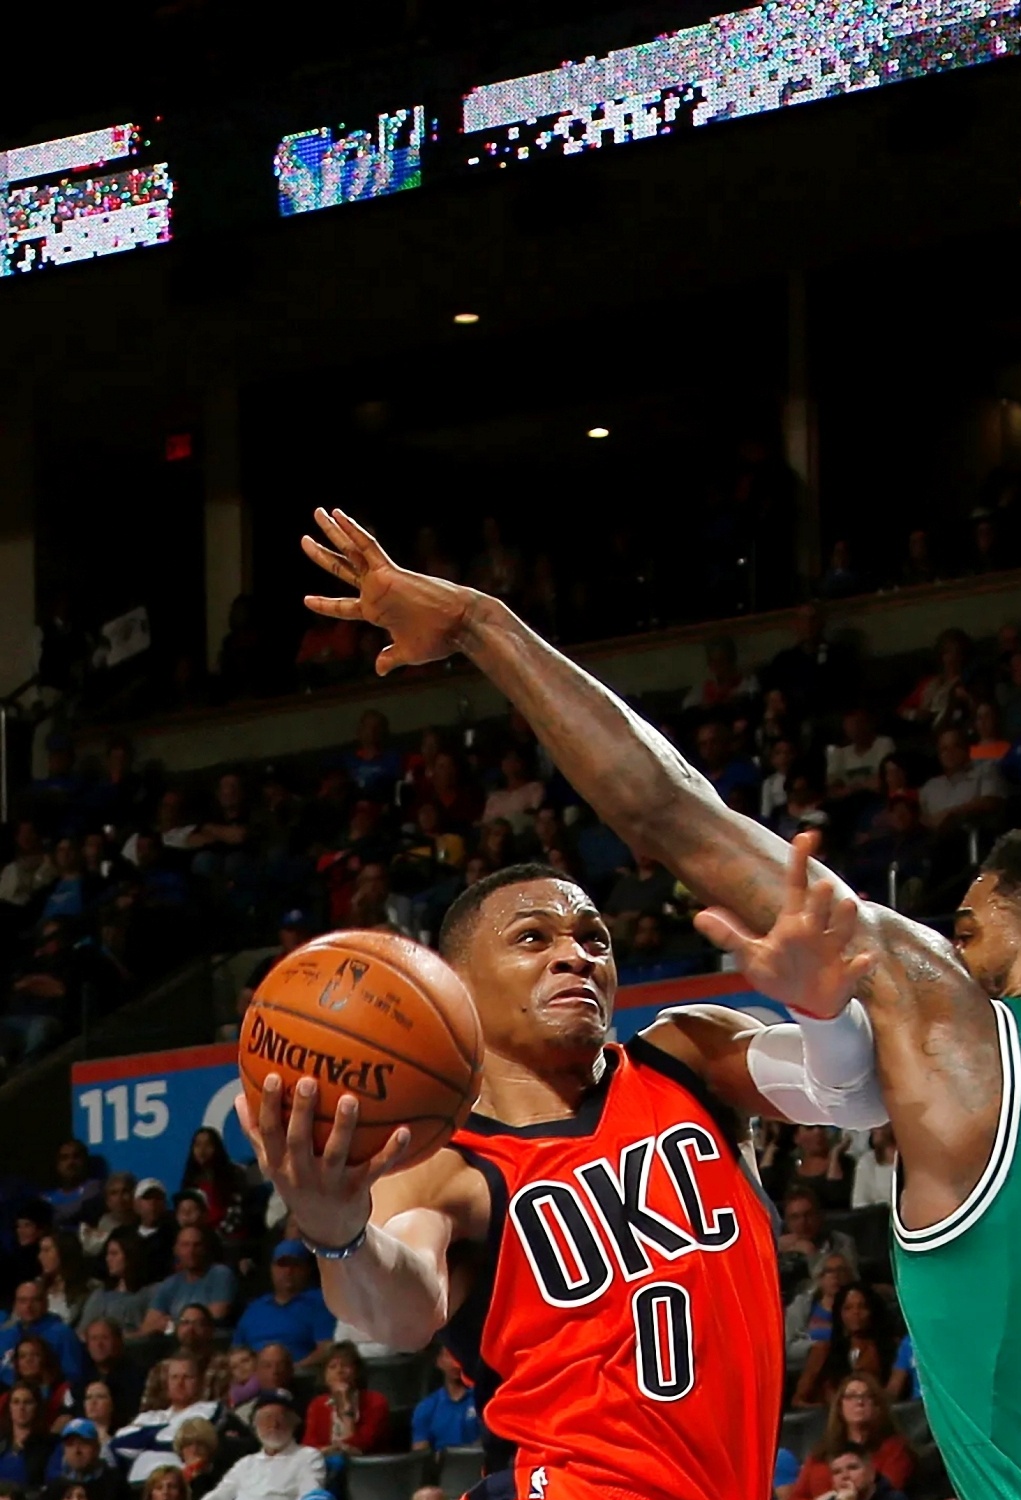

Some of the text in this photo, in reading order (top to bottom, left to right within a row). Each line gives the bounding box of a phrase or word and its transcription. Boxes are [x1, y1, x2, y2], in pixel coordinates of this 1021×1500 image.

[248, 1016, 394, 1100] SPALDING
[79, 1079, 169, 1144] 115
[509, 1122, 739, 1308] OKC
[632, 1281, 694, 1401] 0
